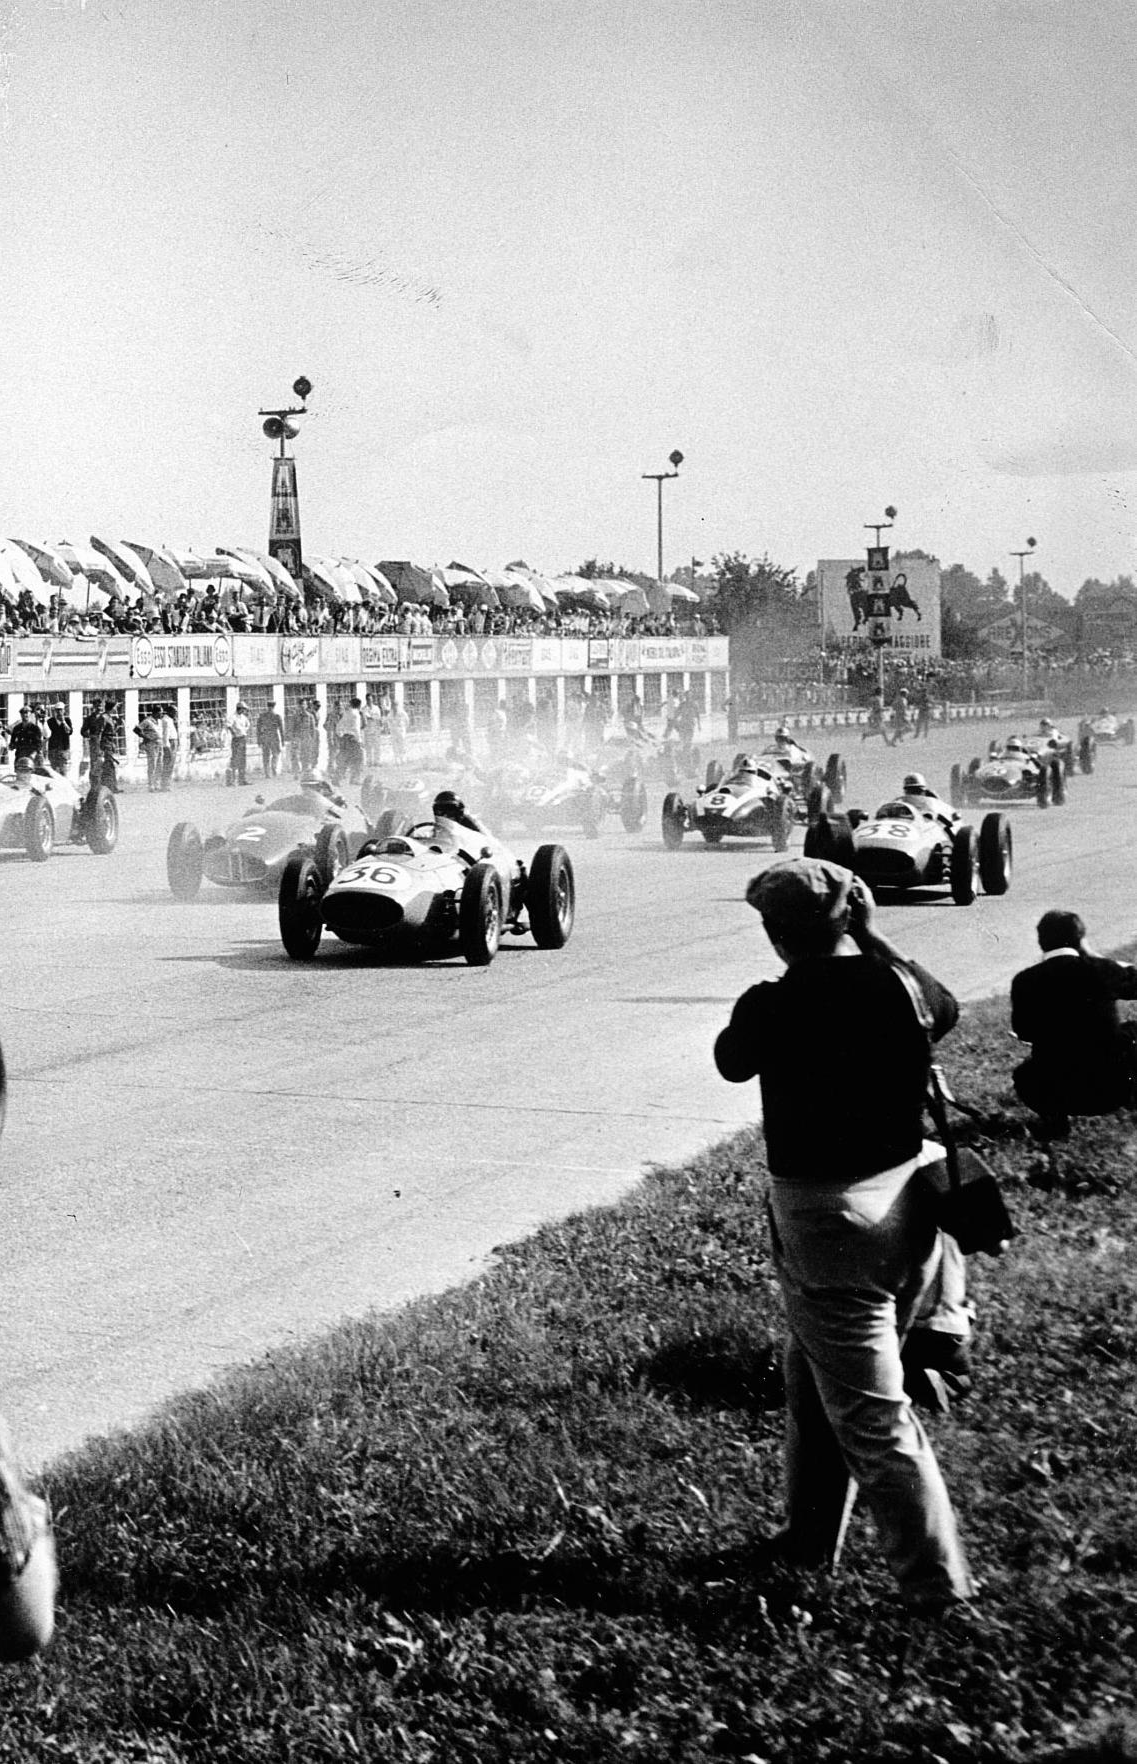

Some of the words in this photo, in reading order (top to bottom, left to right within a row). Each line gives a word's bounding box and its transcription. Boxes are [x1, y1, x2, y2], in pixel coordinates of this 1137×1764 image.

[710, 795, 726, 806] 8
[235, 826, 267, 842] 2
[856, 824, 912, 839] 38
[337, 865, 401, 885] 36
